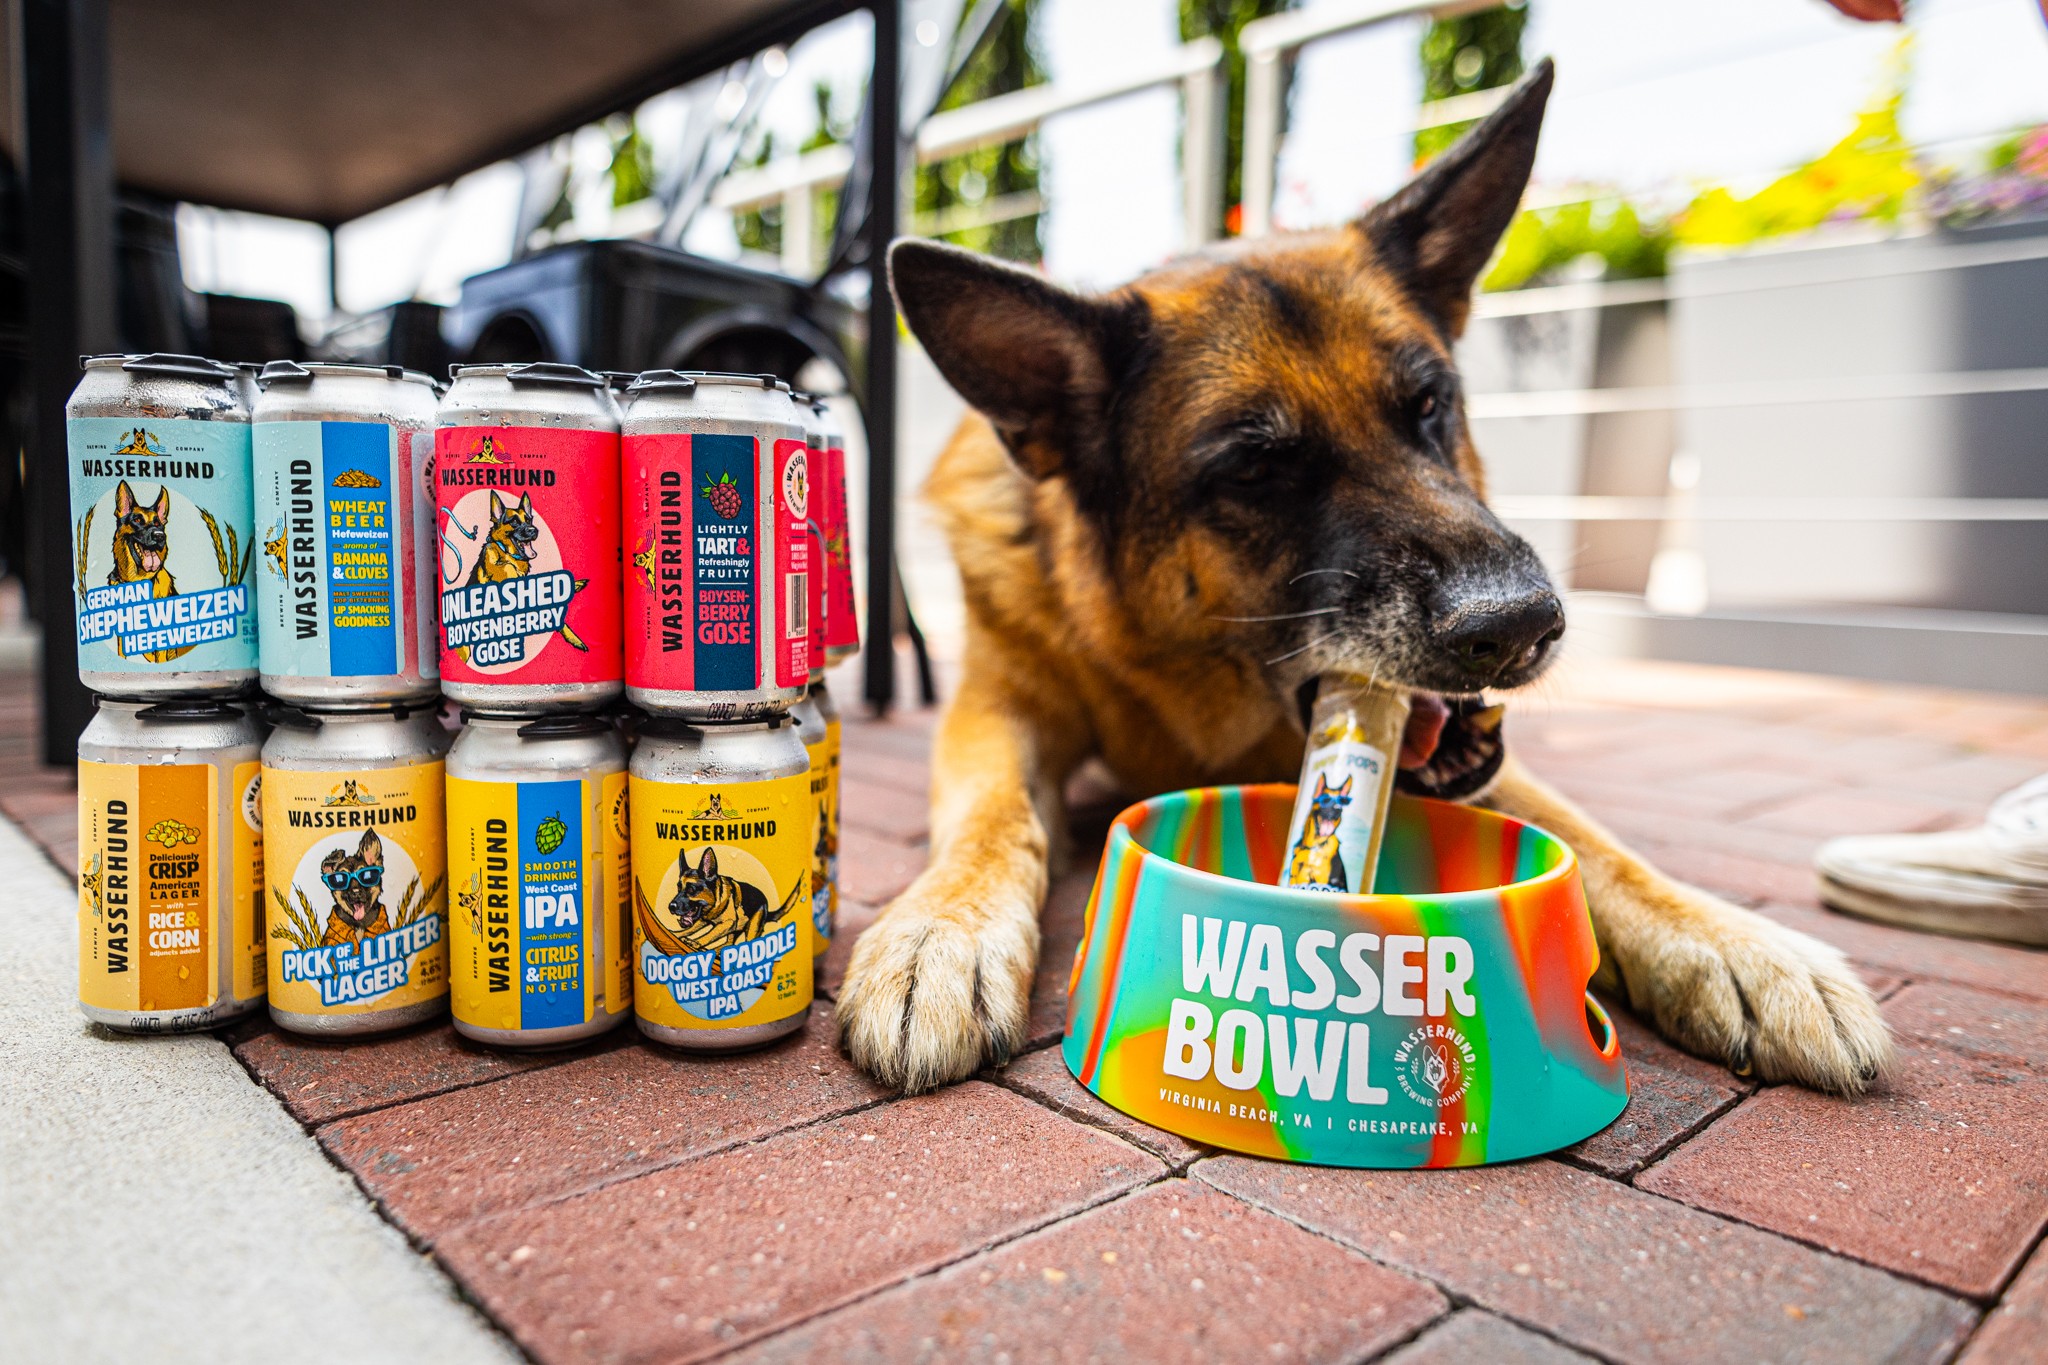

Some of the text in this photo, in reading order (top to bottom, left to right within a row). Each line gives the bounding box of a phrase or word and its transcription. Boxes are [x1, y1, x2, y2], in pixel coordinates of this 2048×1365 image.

[82, 459, 214, 479] WASSERHUND
[442, 468, 556, 487] WASSERHUND
[329, 500, 387, 514] WHEAT
[330, 514, 385, 528] BEER
[698, 525, 748, 534] LIGHTLY
[332, 529, 389, 539] Hefeweizen
[289, 459, 319, 640] WASSERHUND
[332, 552, 388, 565] BANANA
[660, 471, 683, 652] WASSERHUND
[698, 557, 750, 568] Refreshingly
[698, 569, 750, 578] FRUITY
[87, 582, 150, 610] GERMAN
[442, 573, 571, 624] UNLEASHED
[699, 590, 750, 603] BOYSEN-
[80, 587, 245, 642] SHEPHEWEIZEN
[333, 605, 390, 615] LIP SMACKING
[699, 604, 750, 621] BERRY
[334, 615, 391, 627] GOODNESS
[448, 606, 565, 646] BOYSENBERRY
[125, 617, 235, 653] HEFEWEIZEN
[698, 622, 751, 645] GOSE
[475, 638, 521, 663] GOSE
[1346, 753, 1379, 775] POPS
[288, 805, 417, 828] WASSERHUND
[655, 820, 777, 841] WASSERHUND
[150, 853, 199, 861] Deliciously
[524, 860, 577, 872] SMOOTH
[149, 861, 199, 879] CRISP
[524, 870, 577, 882] DRINKING
[107, 800, 129, 973] WASSERHUND
[150, 881, 200, 890] American
[150, 889, 200, 900] LAGER
[524, 882, 578, 894] West Coast
[486, 819, 510, 993] WASSERHUND
[525, 893, 579, 929] IPA
[149, 928, 200, 949] CORN
[363, 915, 440, 967] LITTER
[531, 931, 572, 941] with strong
[336, 944, 351, 958] OF
[525, 944, 579, 965] CITRUS
[647, 924, 795, 982] DOGGY PADDLE
[284, 948, 333, 980] PICK
[338, 957, 360, 973] THE
[1182, 913, 1476, 1017] WASSER
[324, 960, 405, 1004] LAGER
[525, 980, 579, 994] NOTES
[675, 962, 772, 1001] WEST COAST
[777, 979, 797, 991] 6.7%
[709, 995, 738, 1016] IPA
[1163, 997, 1389, 1105] BOWL
[1394, 1024, 1476, 1064] WASSERHUND
[1397, 1074, 1473, 1107] BREWING COMPANY
[1159, 1088, 1221, 1114] VIRGINIA
[1229, 1103, 1285, 1127] BEACH,
[1293, 1112, 1313, 1129] VA
[1348, 1118, 1453, 1137] CHESAPEAKE,
[1460, 1121, 1478, 1135] VA
